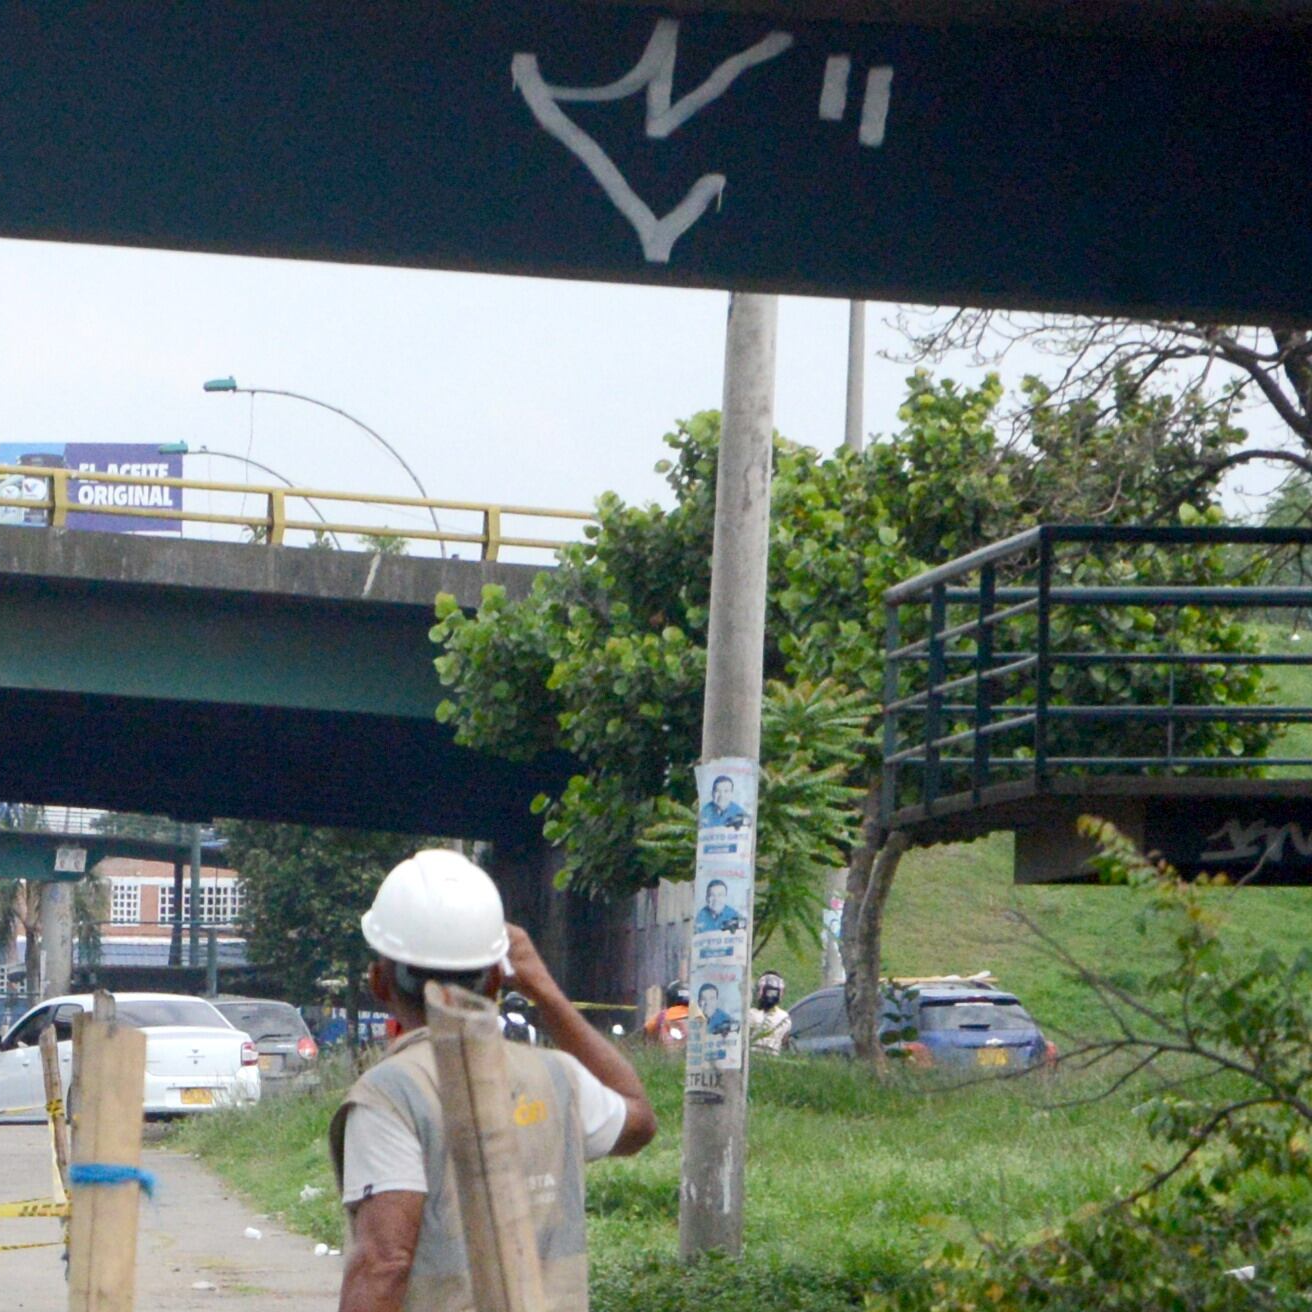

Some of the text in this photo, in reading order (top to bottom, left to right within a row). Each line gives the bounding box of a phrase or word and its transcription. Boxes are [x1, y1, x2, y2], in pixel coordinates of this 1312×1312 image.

[107, 463, 169, 479] ACEITE
[78, 485, 173, 506] ORIGINAL
[686, 1072, 724, 1089] TFLIX
